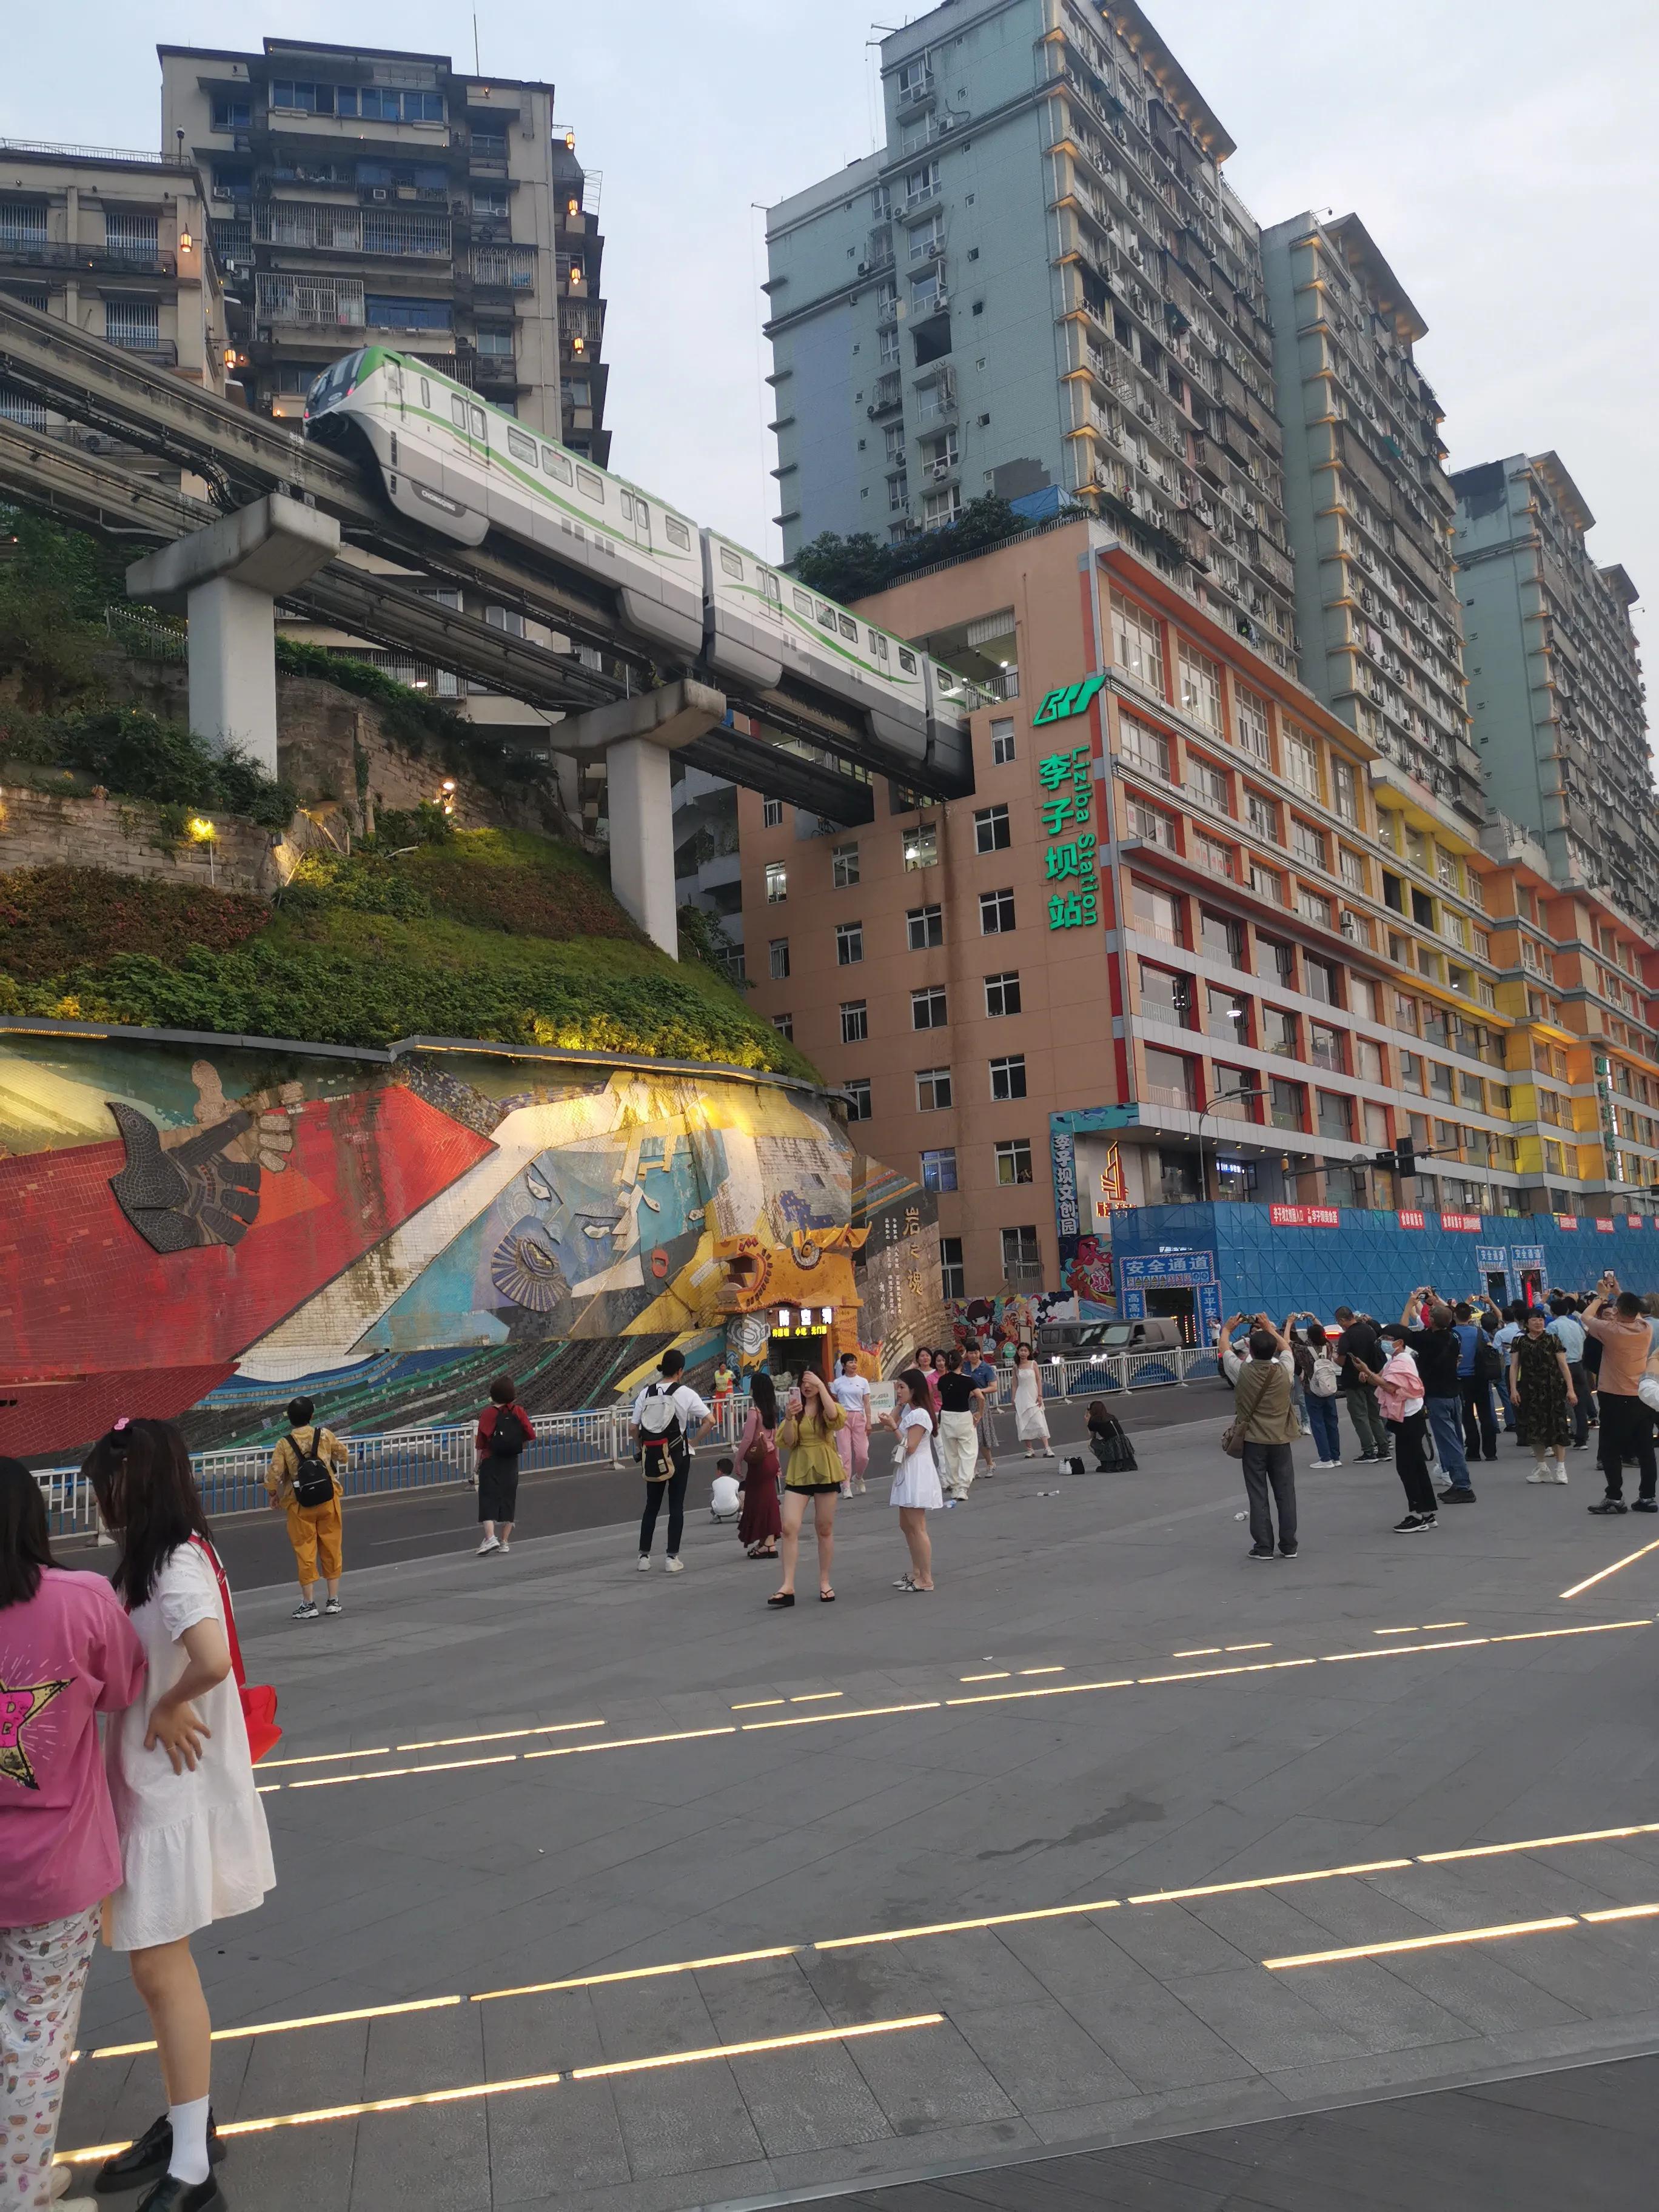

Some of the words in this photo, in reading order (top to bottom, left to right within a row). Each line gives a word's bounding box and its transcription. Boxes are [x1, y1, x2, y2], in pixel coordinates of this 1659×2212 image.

[421, 490, 455, 511] CHONGQING
[1072, 745, 1094, 823] Liziba
[1039, 753, 1082, 931] 李子坝站
[1077, 833, 1100, 927] Station
[1053, 1133, 1077, 1235] 李子坝文创园
[903, 1207, 922, 1296] 岩之魂
[1126, 1256, 1209, 1275] 安全通道
